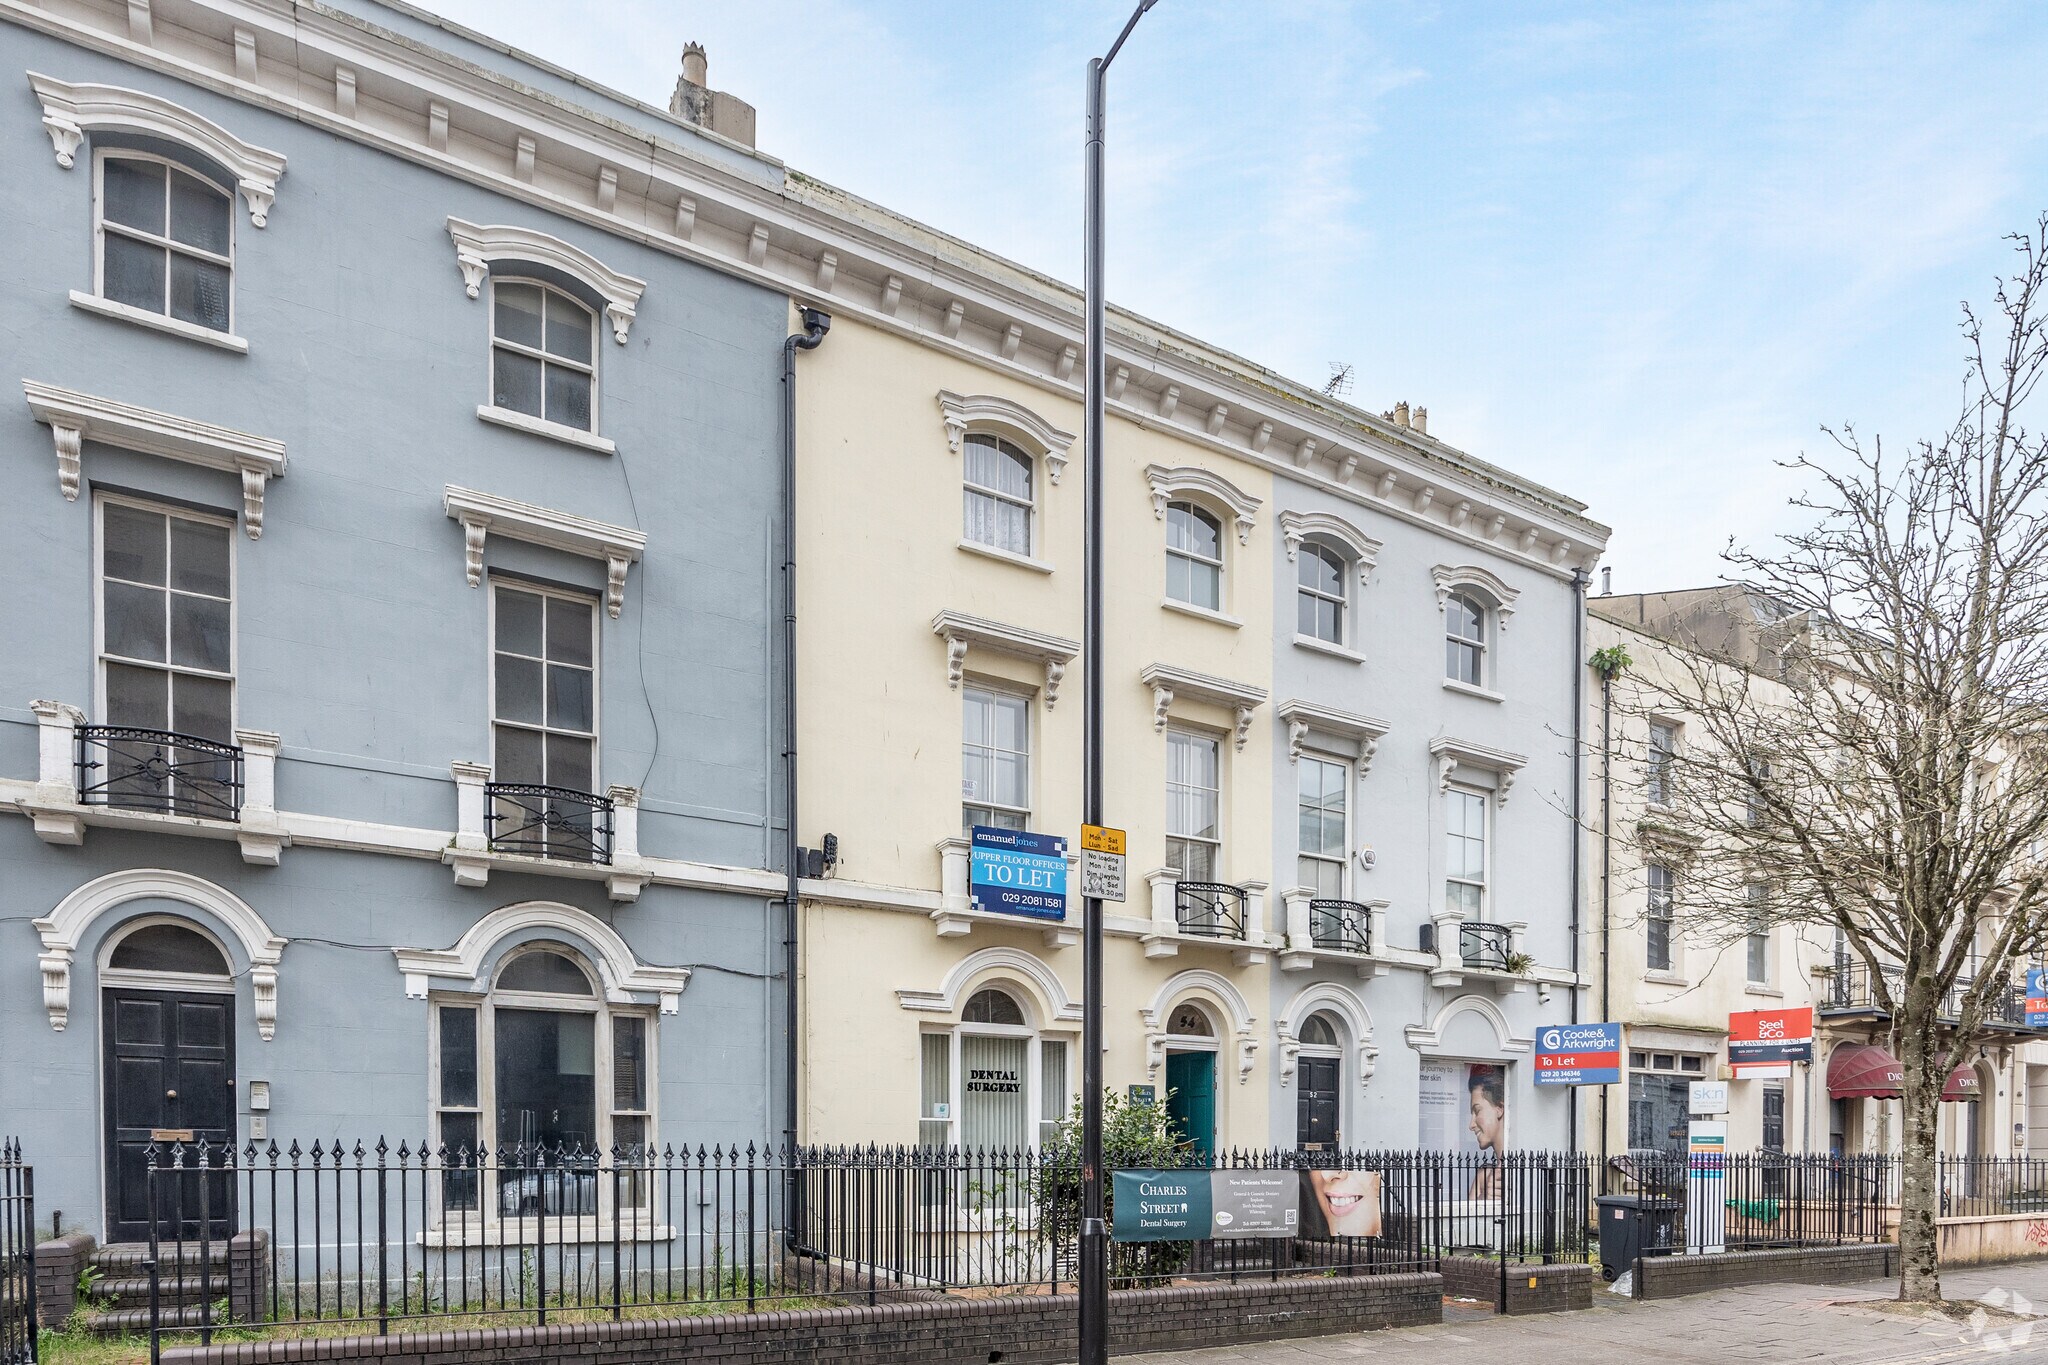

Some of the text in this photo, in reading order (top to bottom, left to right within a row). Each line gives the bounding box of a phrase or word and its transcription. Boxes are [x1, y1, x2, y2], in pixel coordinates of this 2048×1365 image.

[977, 833, 1038, 847] emanueljones
[1108, 836, 1118, 844] Sat
[974, 852, 1065, 870] UPPER FLOOR OFFICES
[1099, 855, 1118, 864] loading
[984, 864, 1056, 888] TO LET
[1002, 892, 1062, 908] 029 2081 1581
[1016, 906, 1061, 914] emanuel-jones.co.uk
[1180, 1016, 1195, 1028] 54
[1759, 1019, 1784, 1029] Seel
[1562, 1028, 1605, 1039] Cooke&
[1759, 1029, 1784, 1038] &Co
[1562, 1038, 1615, 1050] Arkwright
[1542, 1056, 1575, 1066] To Let
[970, 1070, 1018, 1080] DENTAL
[967, 1082, 1020, 1092] SURGERY
[1140, 1182, 1187, 1196] CHARLES
[1140, 1201, 1179, 1214] STREET
[1140, 1218, 1187, 1228] Dental Surgery
